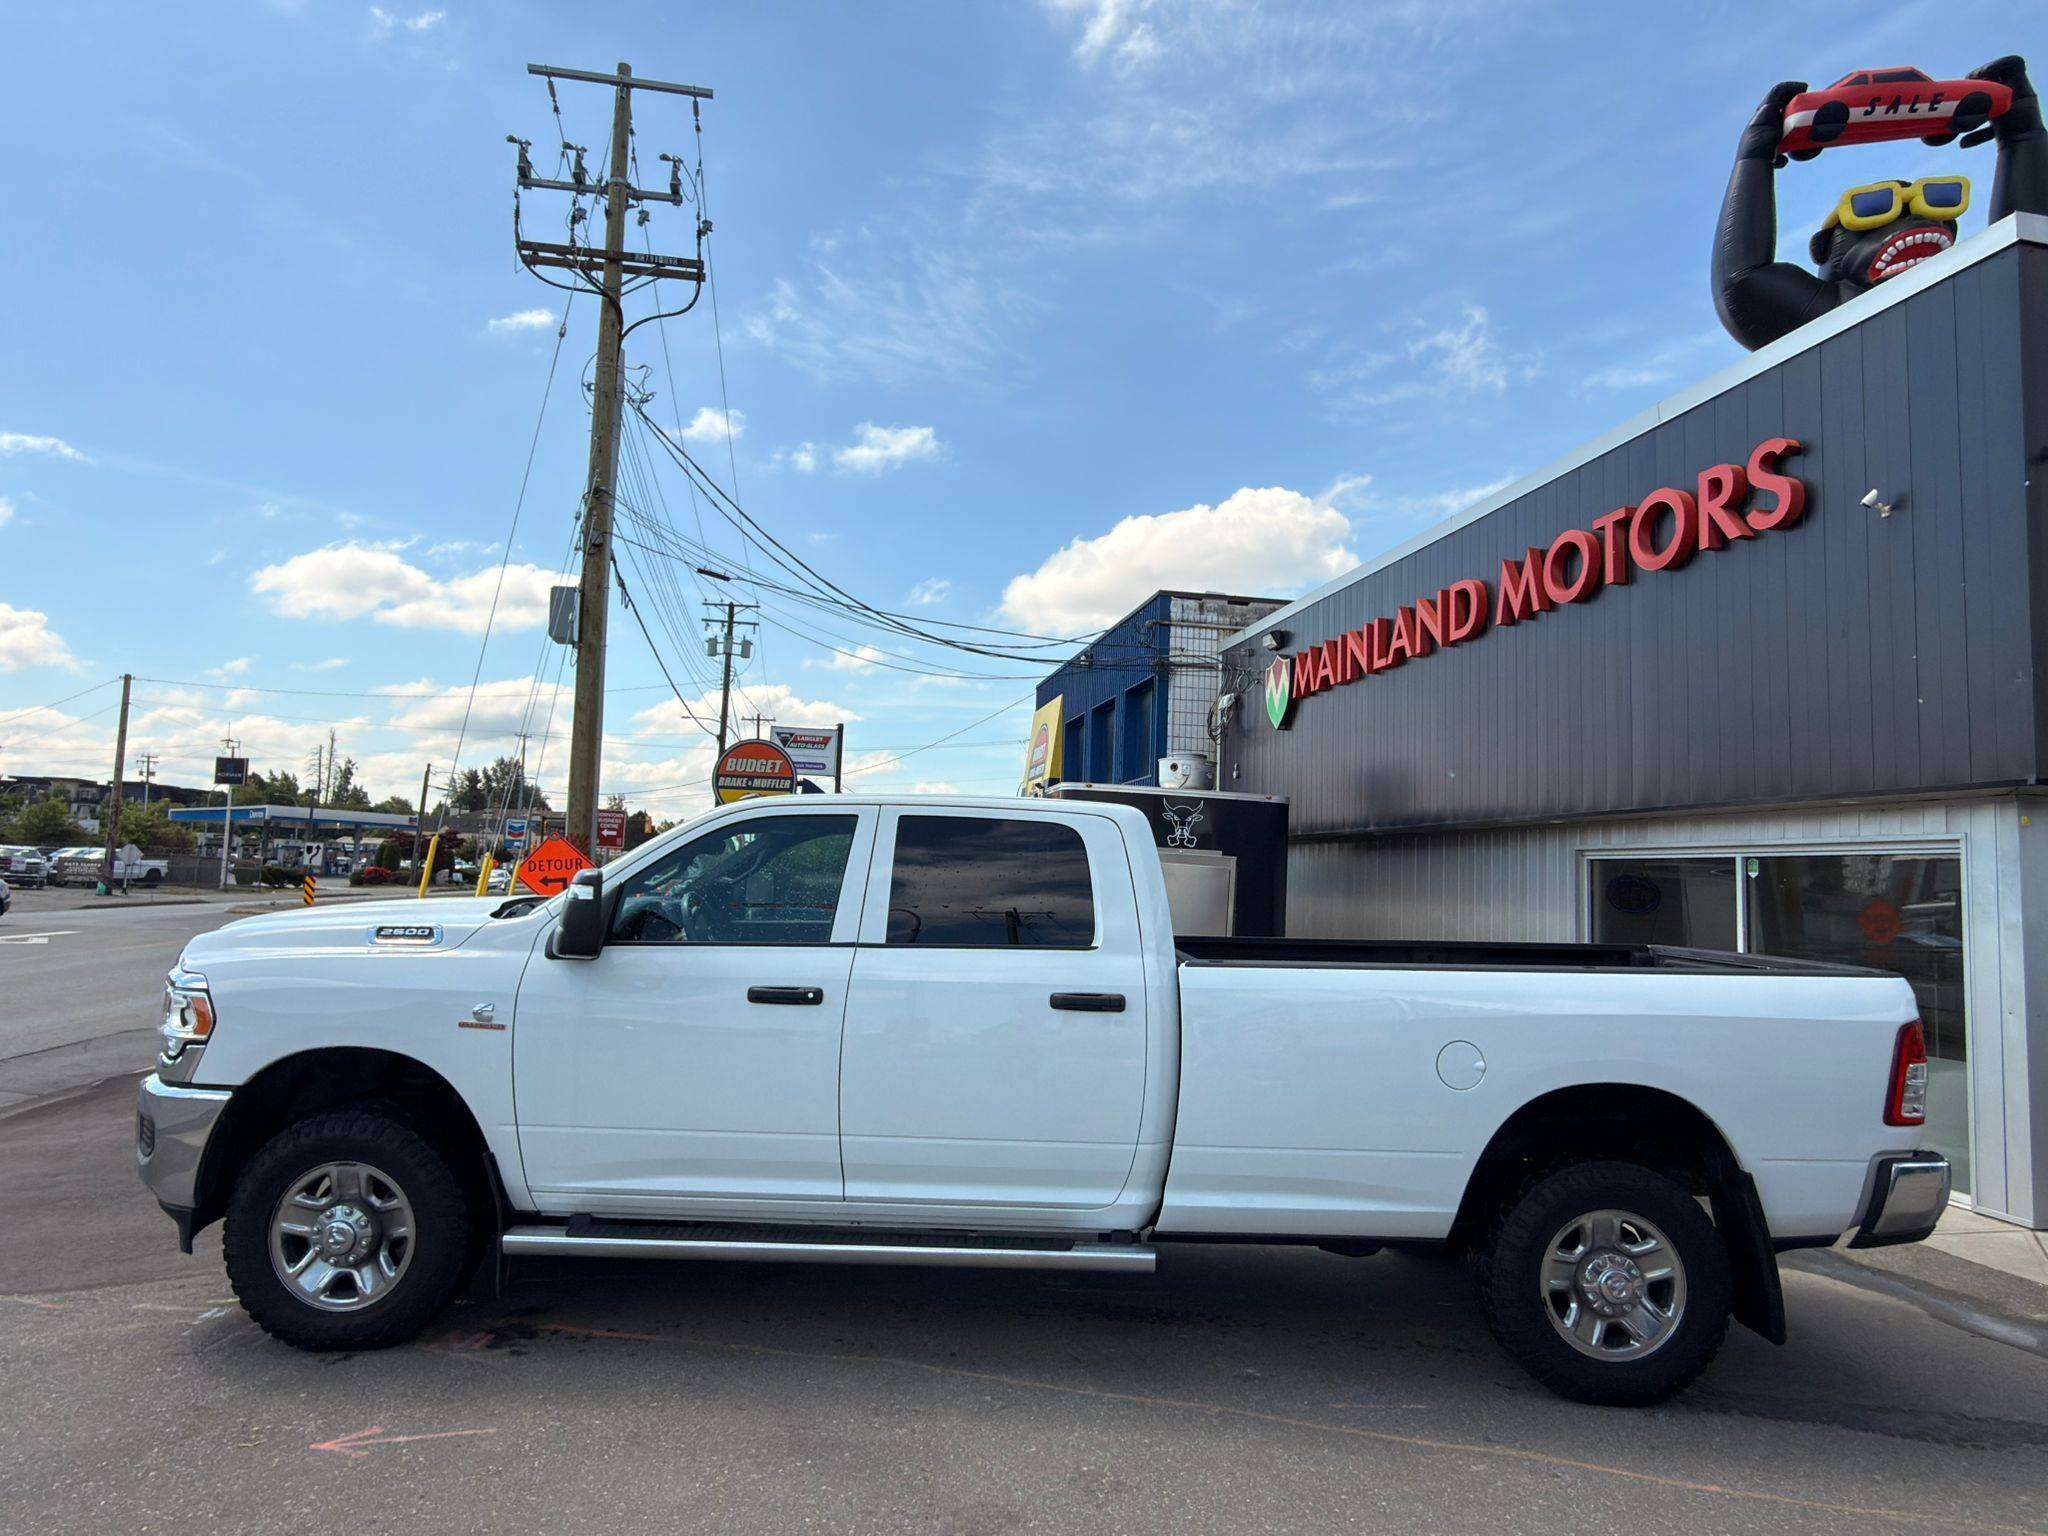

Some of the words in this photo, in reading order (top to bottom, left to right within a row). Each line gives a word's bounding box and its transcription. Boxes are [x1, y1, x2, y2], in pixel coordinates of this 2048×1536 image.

[1863, 93, 1945, 117] SALE
[1292, 579, 1488, 699] MAINLAND
[1496, 438, 1805, 627] MOTORS
[725, 757, 784, 774] BUDGET
[718, 776, 748, 788] BRAKE
[753, 778, 791, 789] MUFFLER
[528, 859, 584, 873] DETOUR
